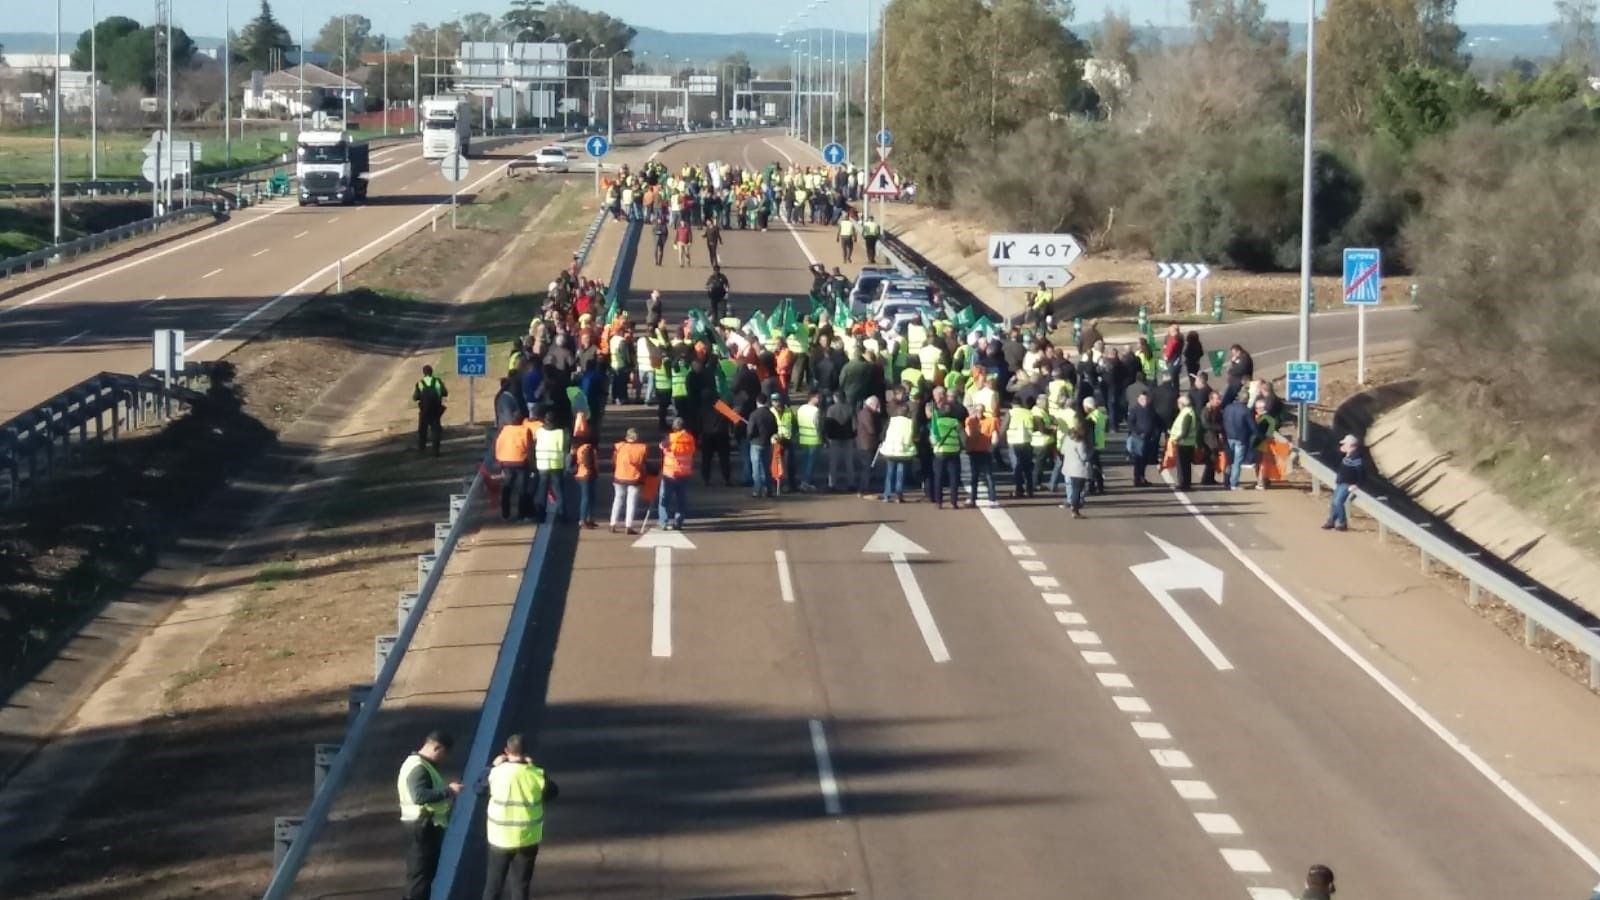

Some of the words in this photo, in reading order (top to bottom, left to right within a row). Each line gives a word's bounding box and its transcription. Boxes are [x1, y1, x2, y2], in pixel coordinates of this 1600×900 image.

[1028, 243, 1071, 257] 407
[461, 364, 483, 373] 407
[1290, 390, 1313, 400] 407
